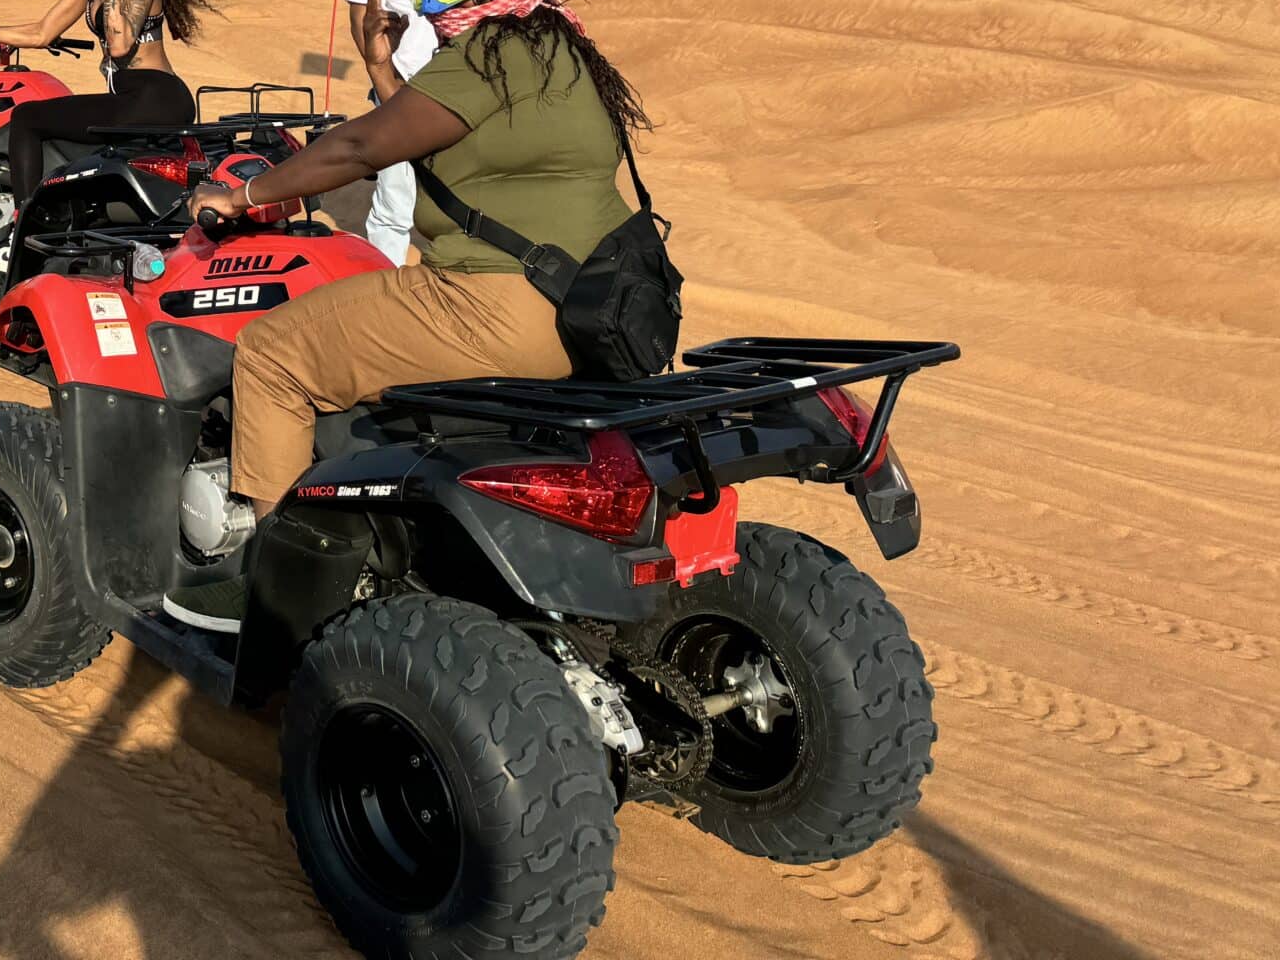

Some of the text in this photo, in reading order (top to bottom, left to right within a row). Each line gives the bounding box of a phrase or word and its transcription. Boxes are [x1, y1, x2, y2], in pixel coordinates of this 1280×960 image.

[192, 285, 260, 309] 250
[297, 486, 336, 497] KYMCO
[337, 486, 362, 497] Since
